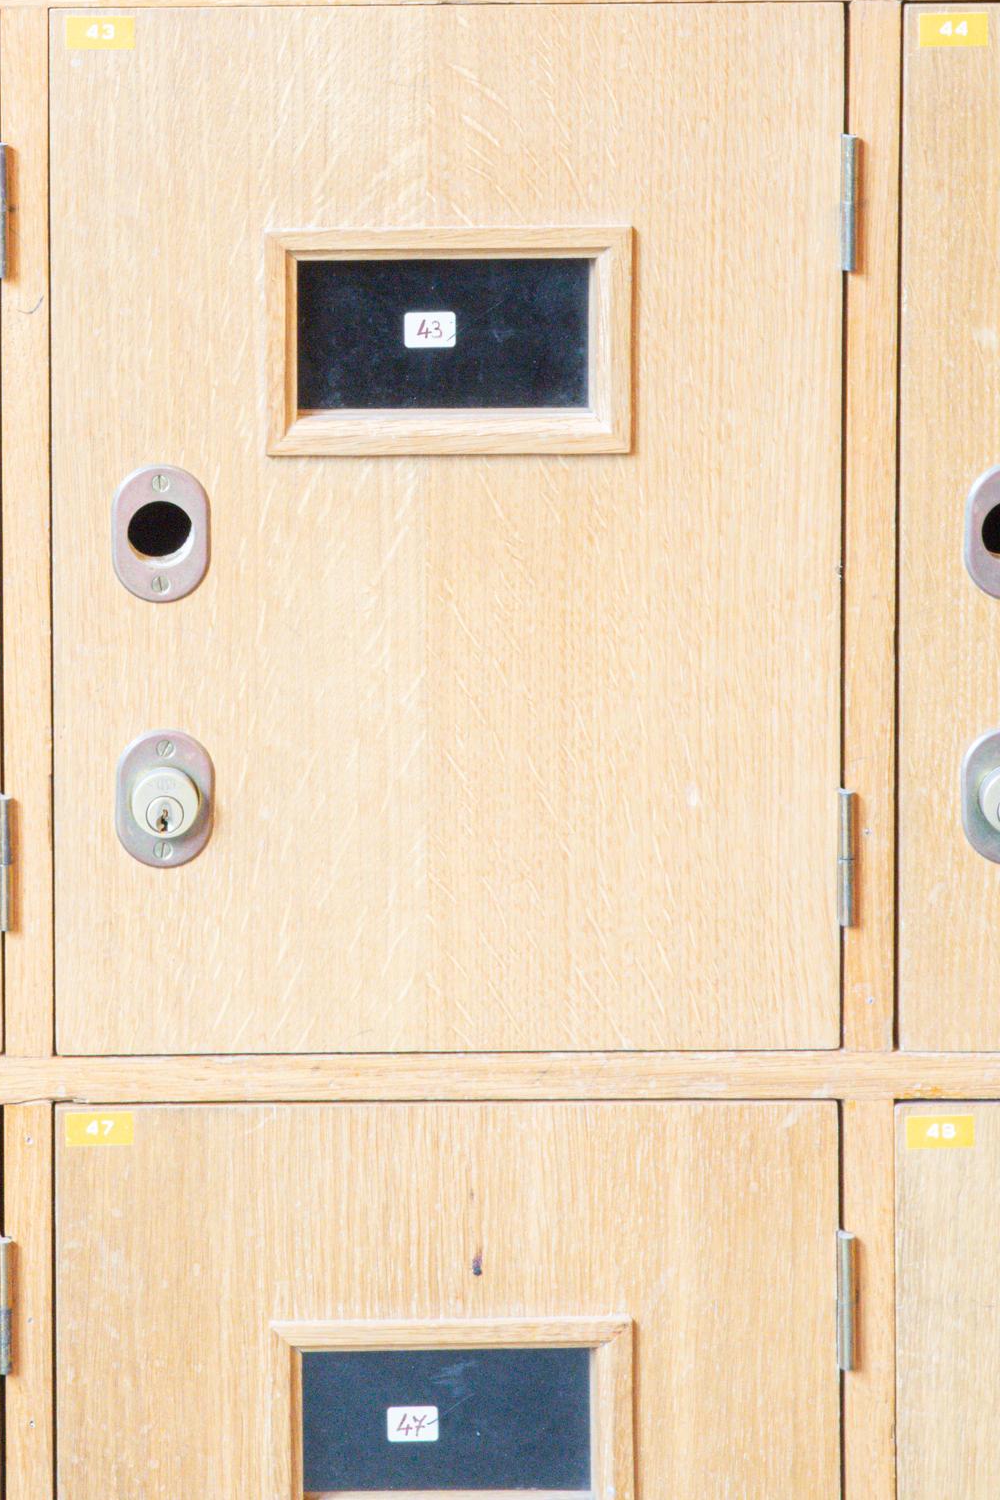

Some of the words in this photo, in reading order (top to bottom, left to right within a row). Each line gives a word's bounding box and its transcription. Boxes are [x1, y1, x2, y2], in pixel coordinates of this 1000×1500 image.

[86, 23, 115, 40] 43
[938, 20, 969, 37] 44
[416, 318, 443, 339] 43
[86, 1119, 115, 1136] 47
[396, 1412, 428, 1437] 47
